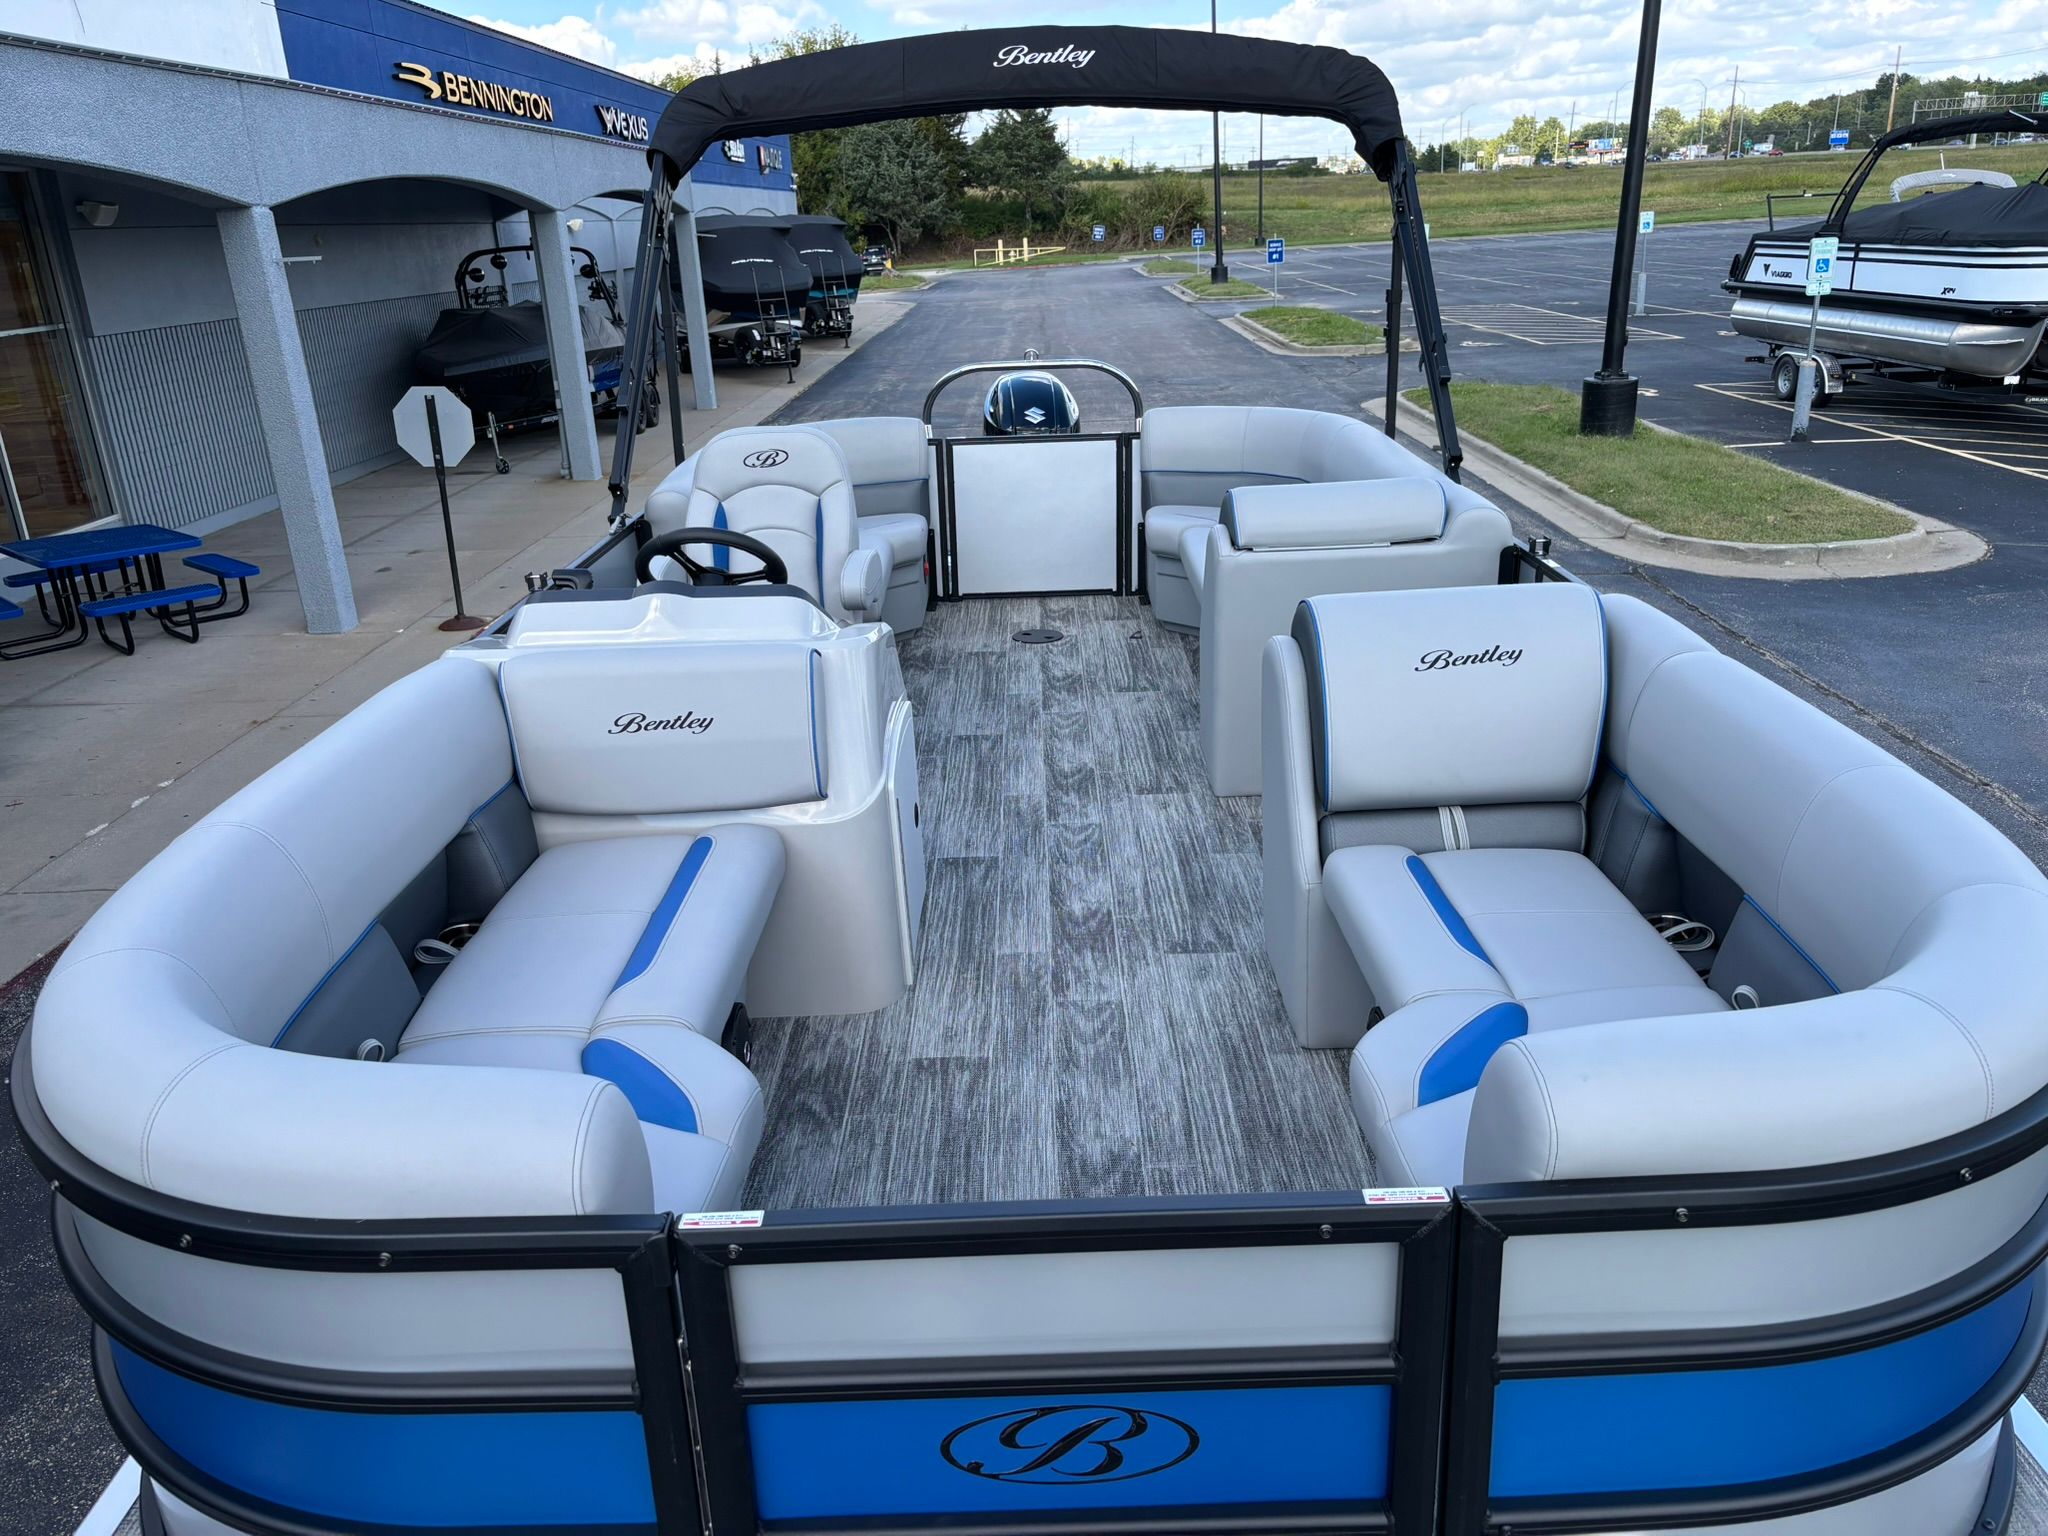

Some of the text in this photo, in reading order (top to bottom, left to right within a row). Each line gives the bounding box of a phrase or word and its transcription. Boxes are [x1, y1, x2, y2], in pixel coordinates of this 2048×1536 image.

[993, 44, 1096, 69] Bentley
[443, 71, 554, 122] BENNINGTON
[611, 107, 649, 141] VEXUS
[1414, 644, 1523, 672] Bentley
[607, 710, 715, 735] Bentley
